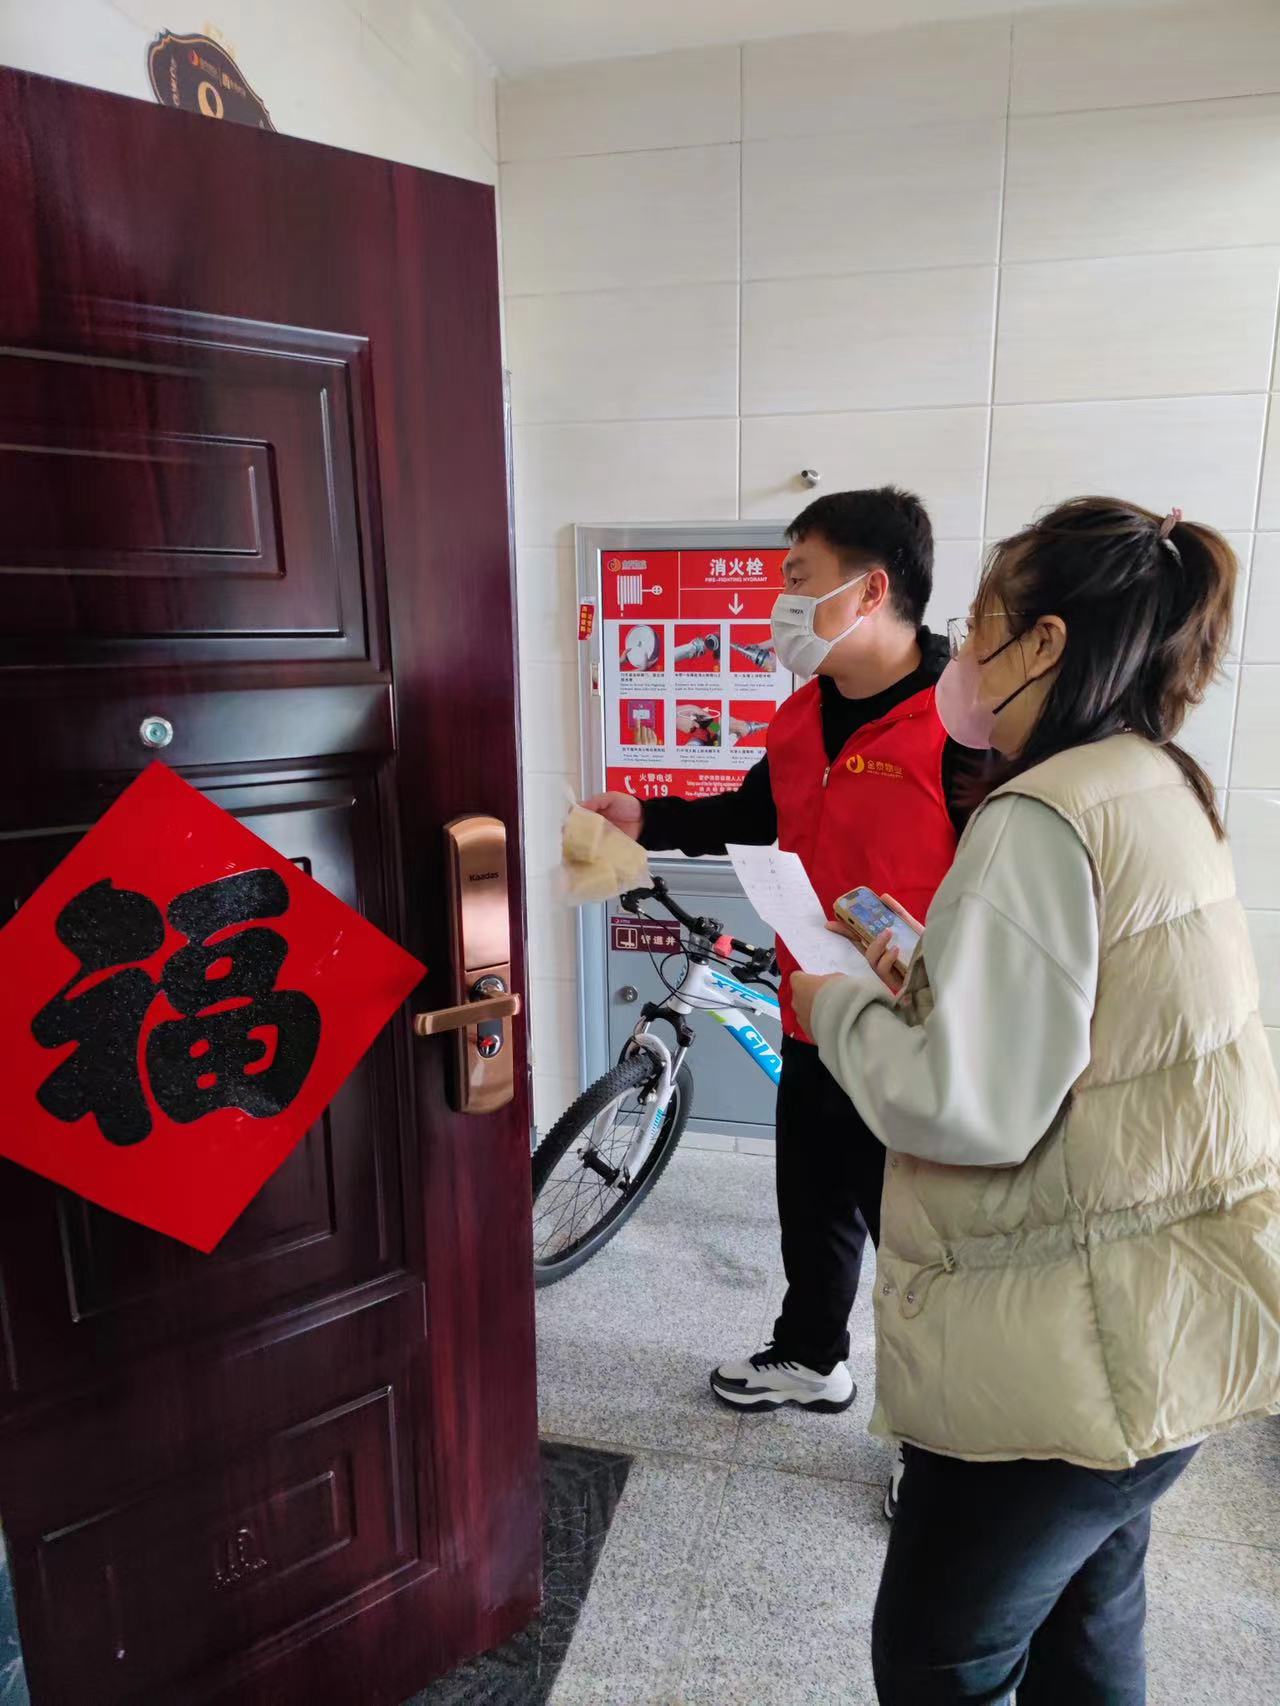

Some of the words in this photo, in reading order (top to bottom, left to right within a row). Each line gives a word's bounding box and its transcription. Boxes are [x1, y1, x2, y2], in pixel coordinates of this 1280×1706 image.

[709, 557, 764, 576] 消火栓
[639, 773, 673, 783] 火警电话
[643, 784, 669, 797] 119
[469, 872, 500, 882] Kaadas
[640, 935, 676, 946] 管道井
[712, 980, 759, 1003] XTC
[31, 868, 322, 1147] 福
